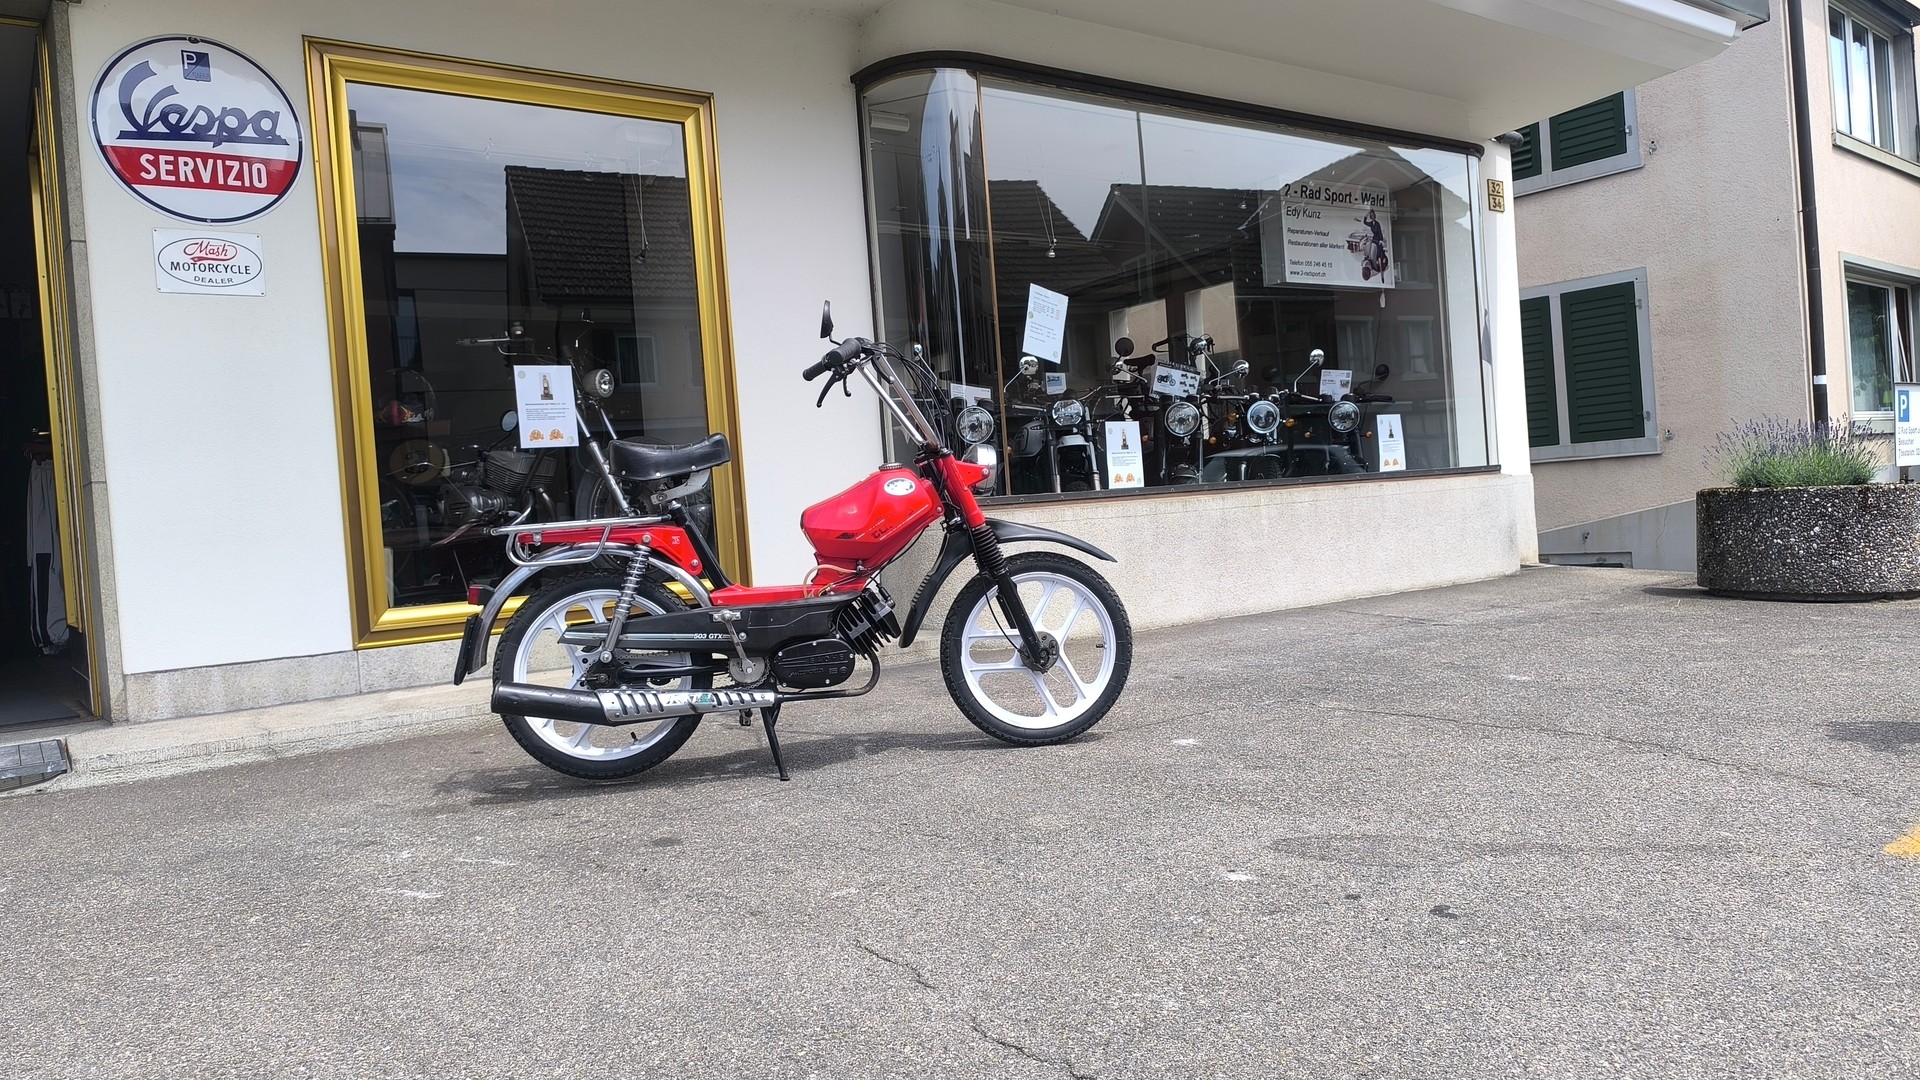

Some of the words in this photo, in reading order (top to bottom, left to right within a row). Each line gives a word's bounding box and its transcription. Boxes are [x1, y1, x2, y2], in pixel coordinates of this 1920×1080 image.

[183, 52, 197, 70] P
[116, 60, 290, 148] Vespa
[139, 153, 268, 189] SERVIZIO
[1284, 183, 1291, 197] 2
[1300, 185, 1321, 200] Rad
[1324, 187, 1353, 205] Sport
[1361, 192, 1386, 207] Wald
[1490, 181, 1501, 194] 32
[1491, 197, 1502, 209] 34
[1286, 206, 1300, 219] Edy
[1302, 207, 1322, 220] Kunz
[184, 240, 236, 261] Mash
[170, 261, 251, 275] MOTORCYCLE
[193, 275, 234, 285] DEALER
[1900, 394, 1908, 418] P
